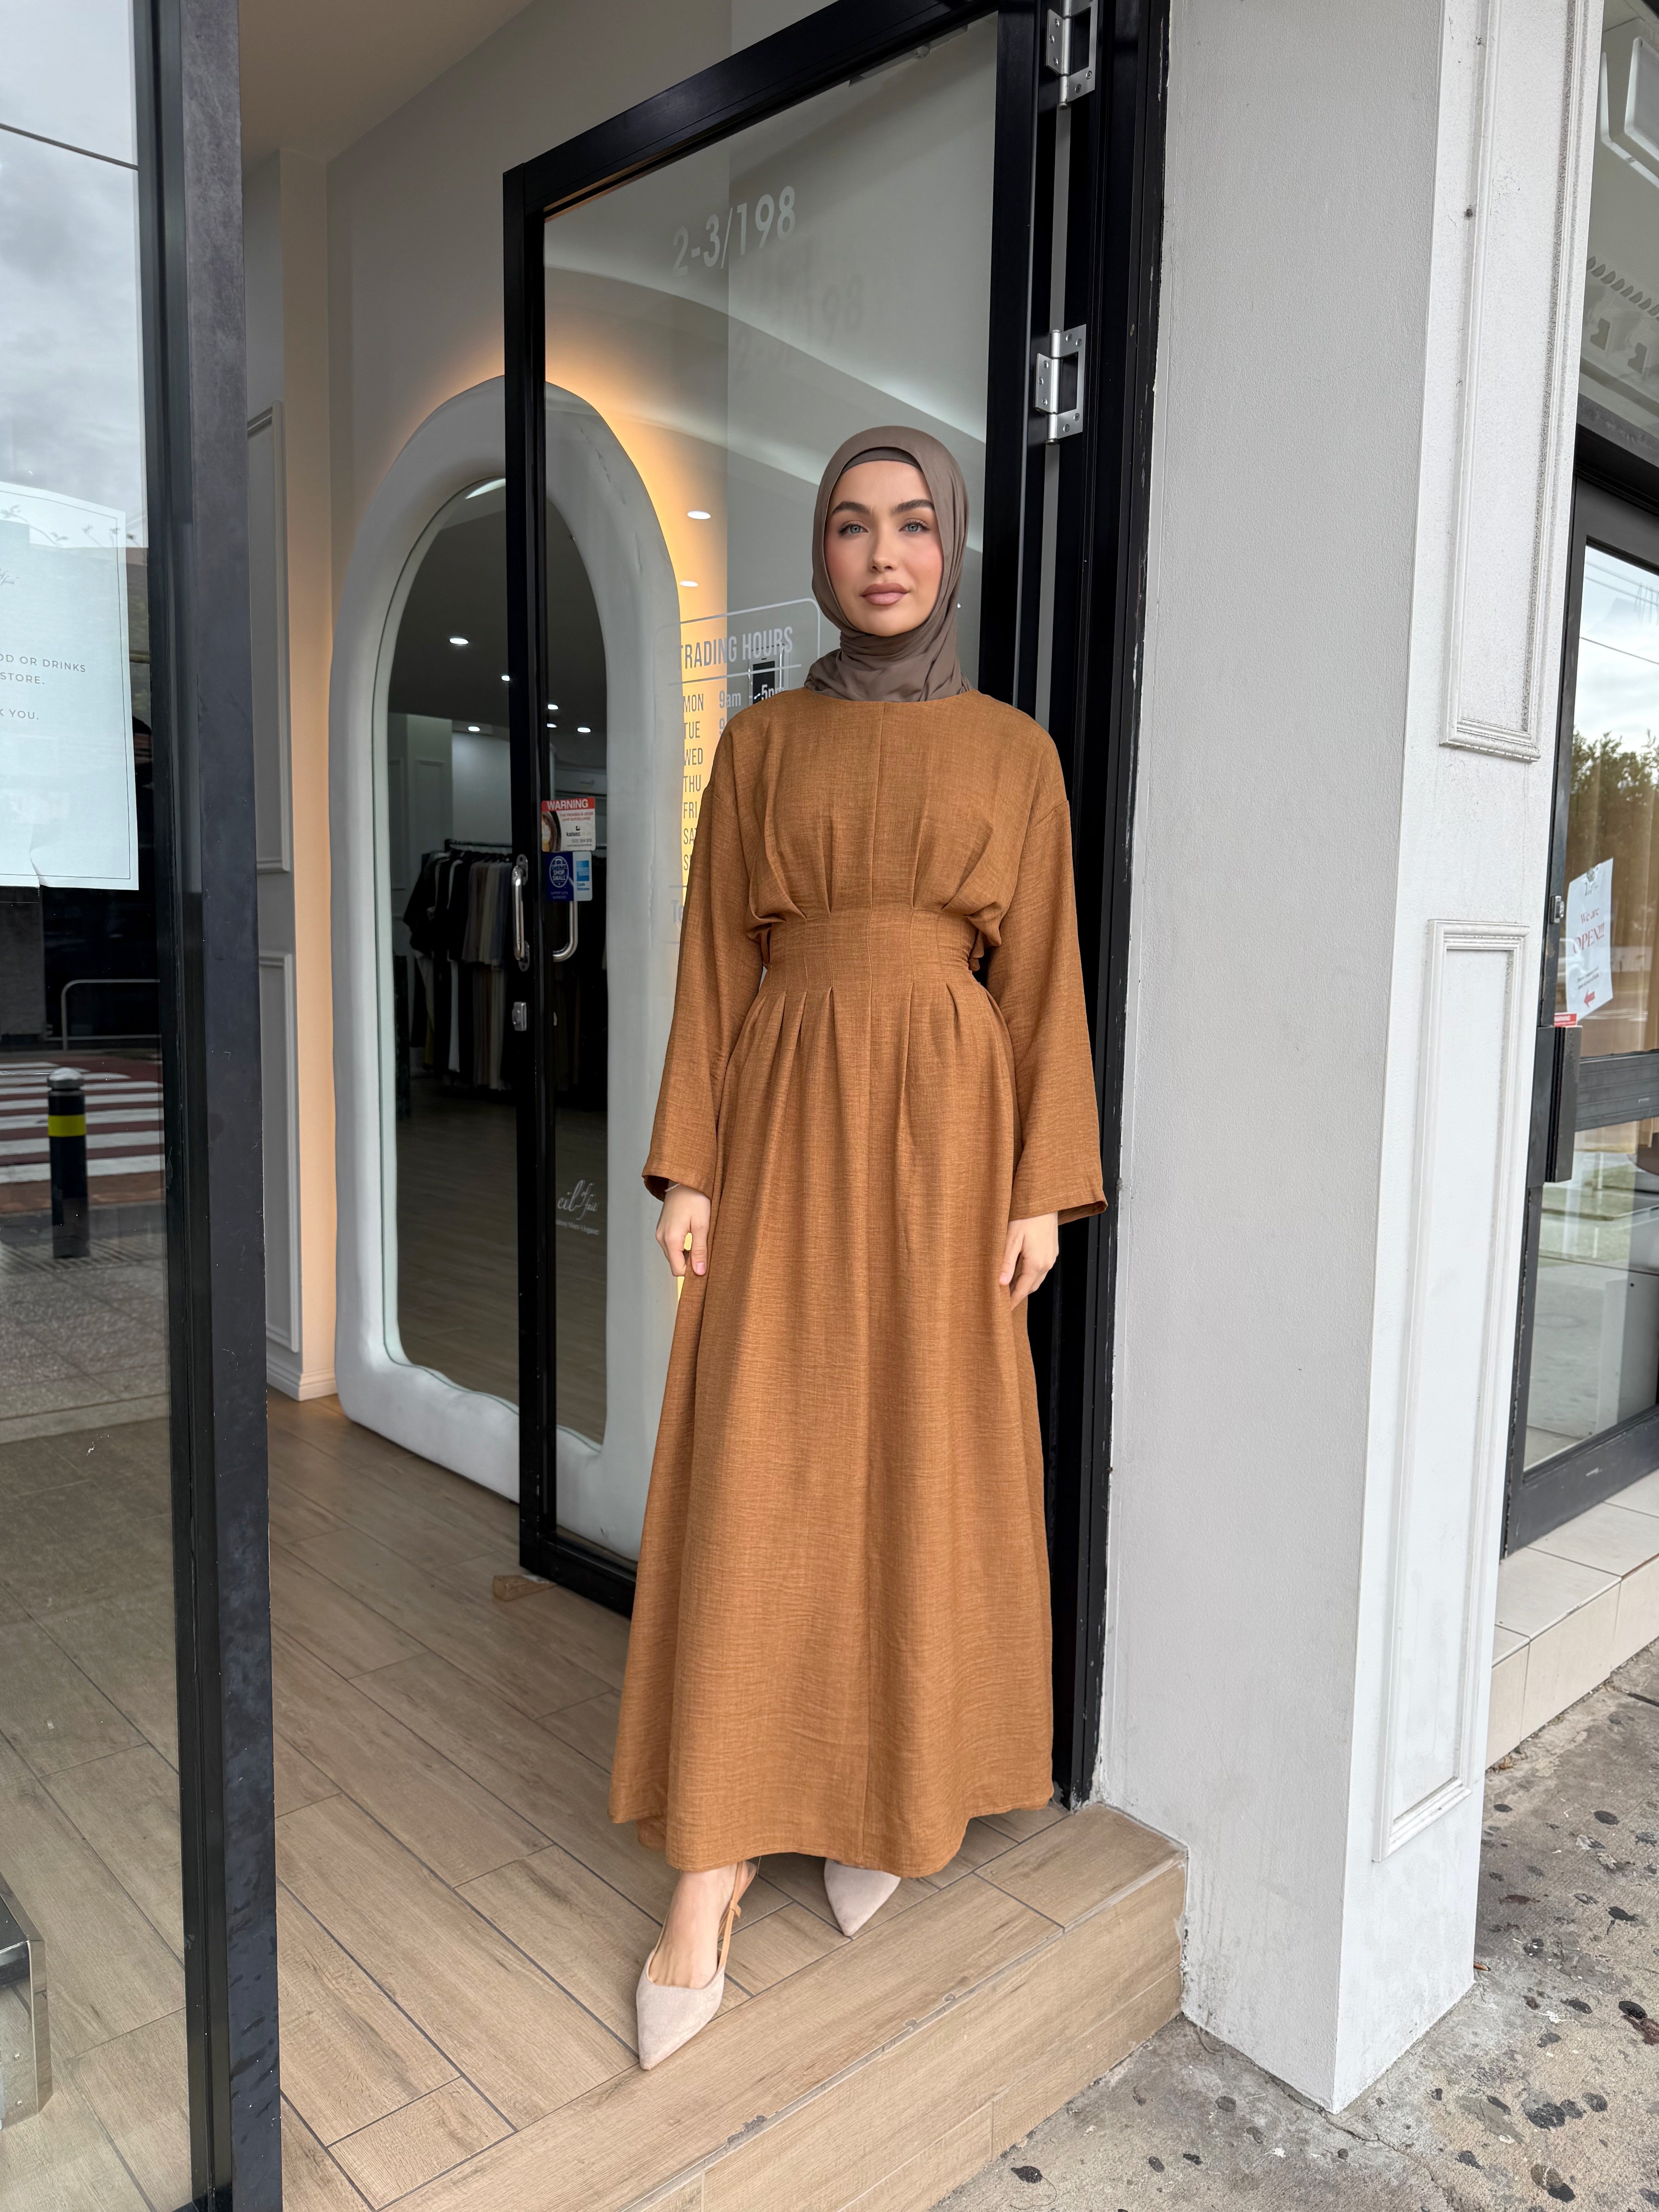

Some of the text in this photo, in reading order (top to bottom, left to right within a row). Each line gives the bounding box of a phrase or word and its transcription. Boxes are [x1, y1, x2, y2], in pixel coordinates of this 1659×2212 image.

[672, 185, 796, 278] 2-3/198
[742, 626, 793, 660] HOURS
[20, 656, 37, 666] OR
[43, 659, 86, 672] DRINKS
[0, 672, 45, 684] STORE.
[683, 694, 704, 713] MON
[719, 690, 741, 709] 9am
[9, 709, 39, 720] YOU.
[684, 721, 700, 740] TUE
[684, 748, 703, 766] WED
[684, 775, 701, 792] THU
[547, 799, 588, 811] WARNING
[684, 801, 697, 819] FRI
[684, 828, 697, 845] SA
[1581, 907, 1600, 924] We are
[1573, 922, 1605, 954] OPEN!!!
